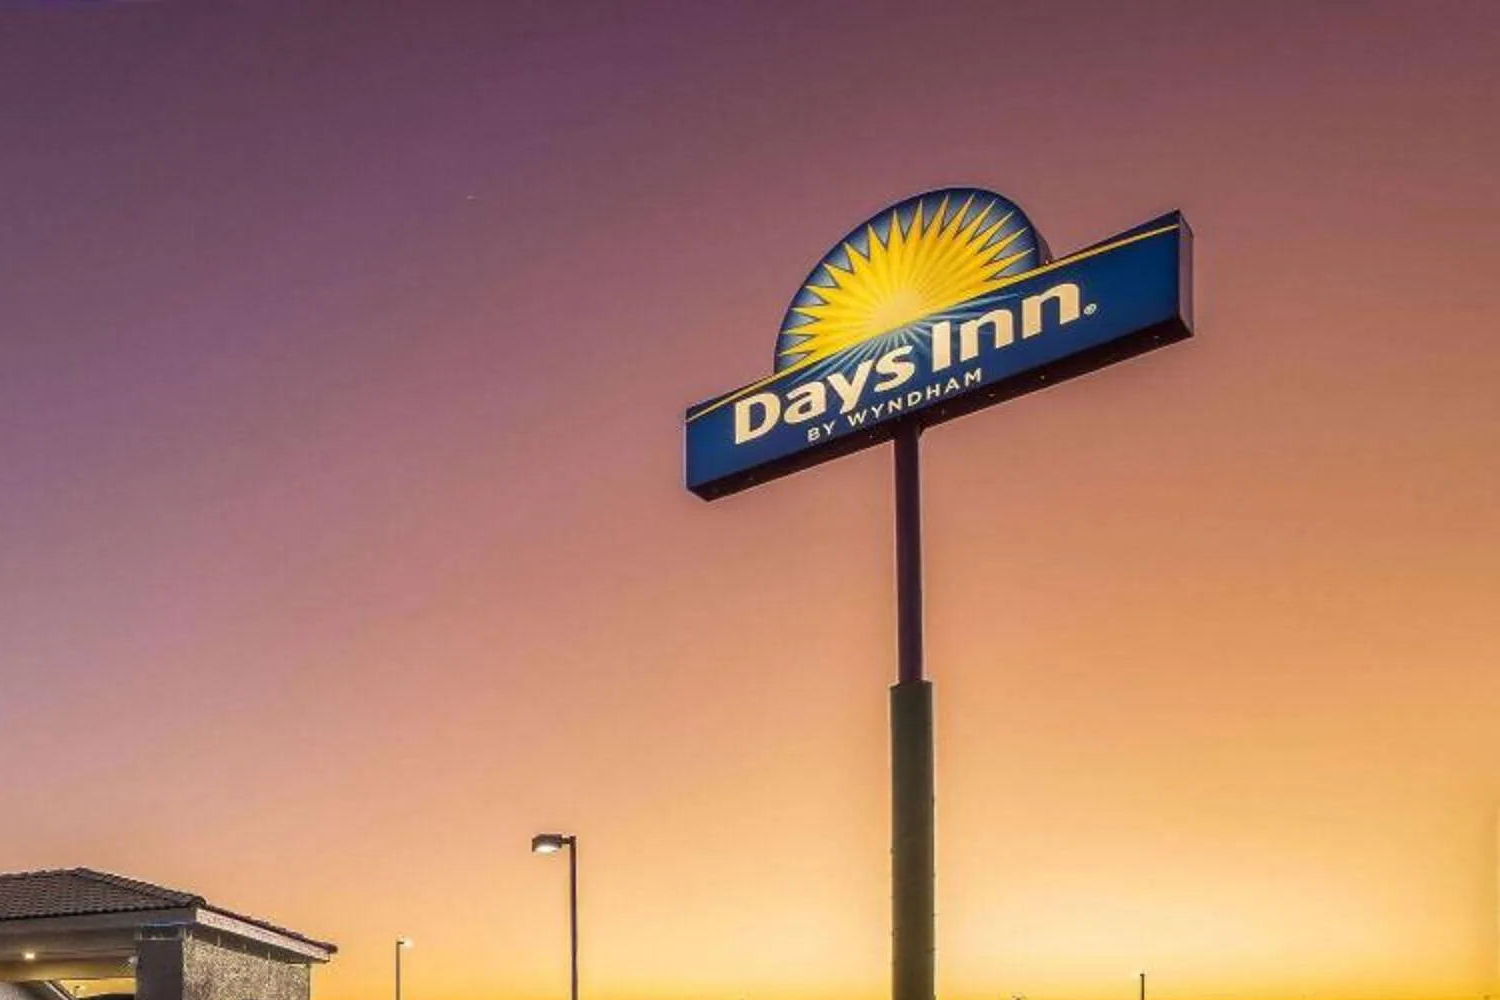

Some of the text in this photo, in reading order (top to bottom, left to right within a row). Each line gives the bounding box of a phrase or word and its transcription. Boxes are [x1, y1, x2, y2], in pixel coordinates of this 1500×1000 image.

[734, 282, 1081, 445] Days Inn
[808, 368, 982, 443] BY WYNDHAM
